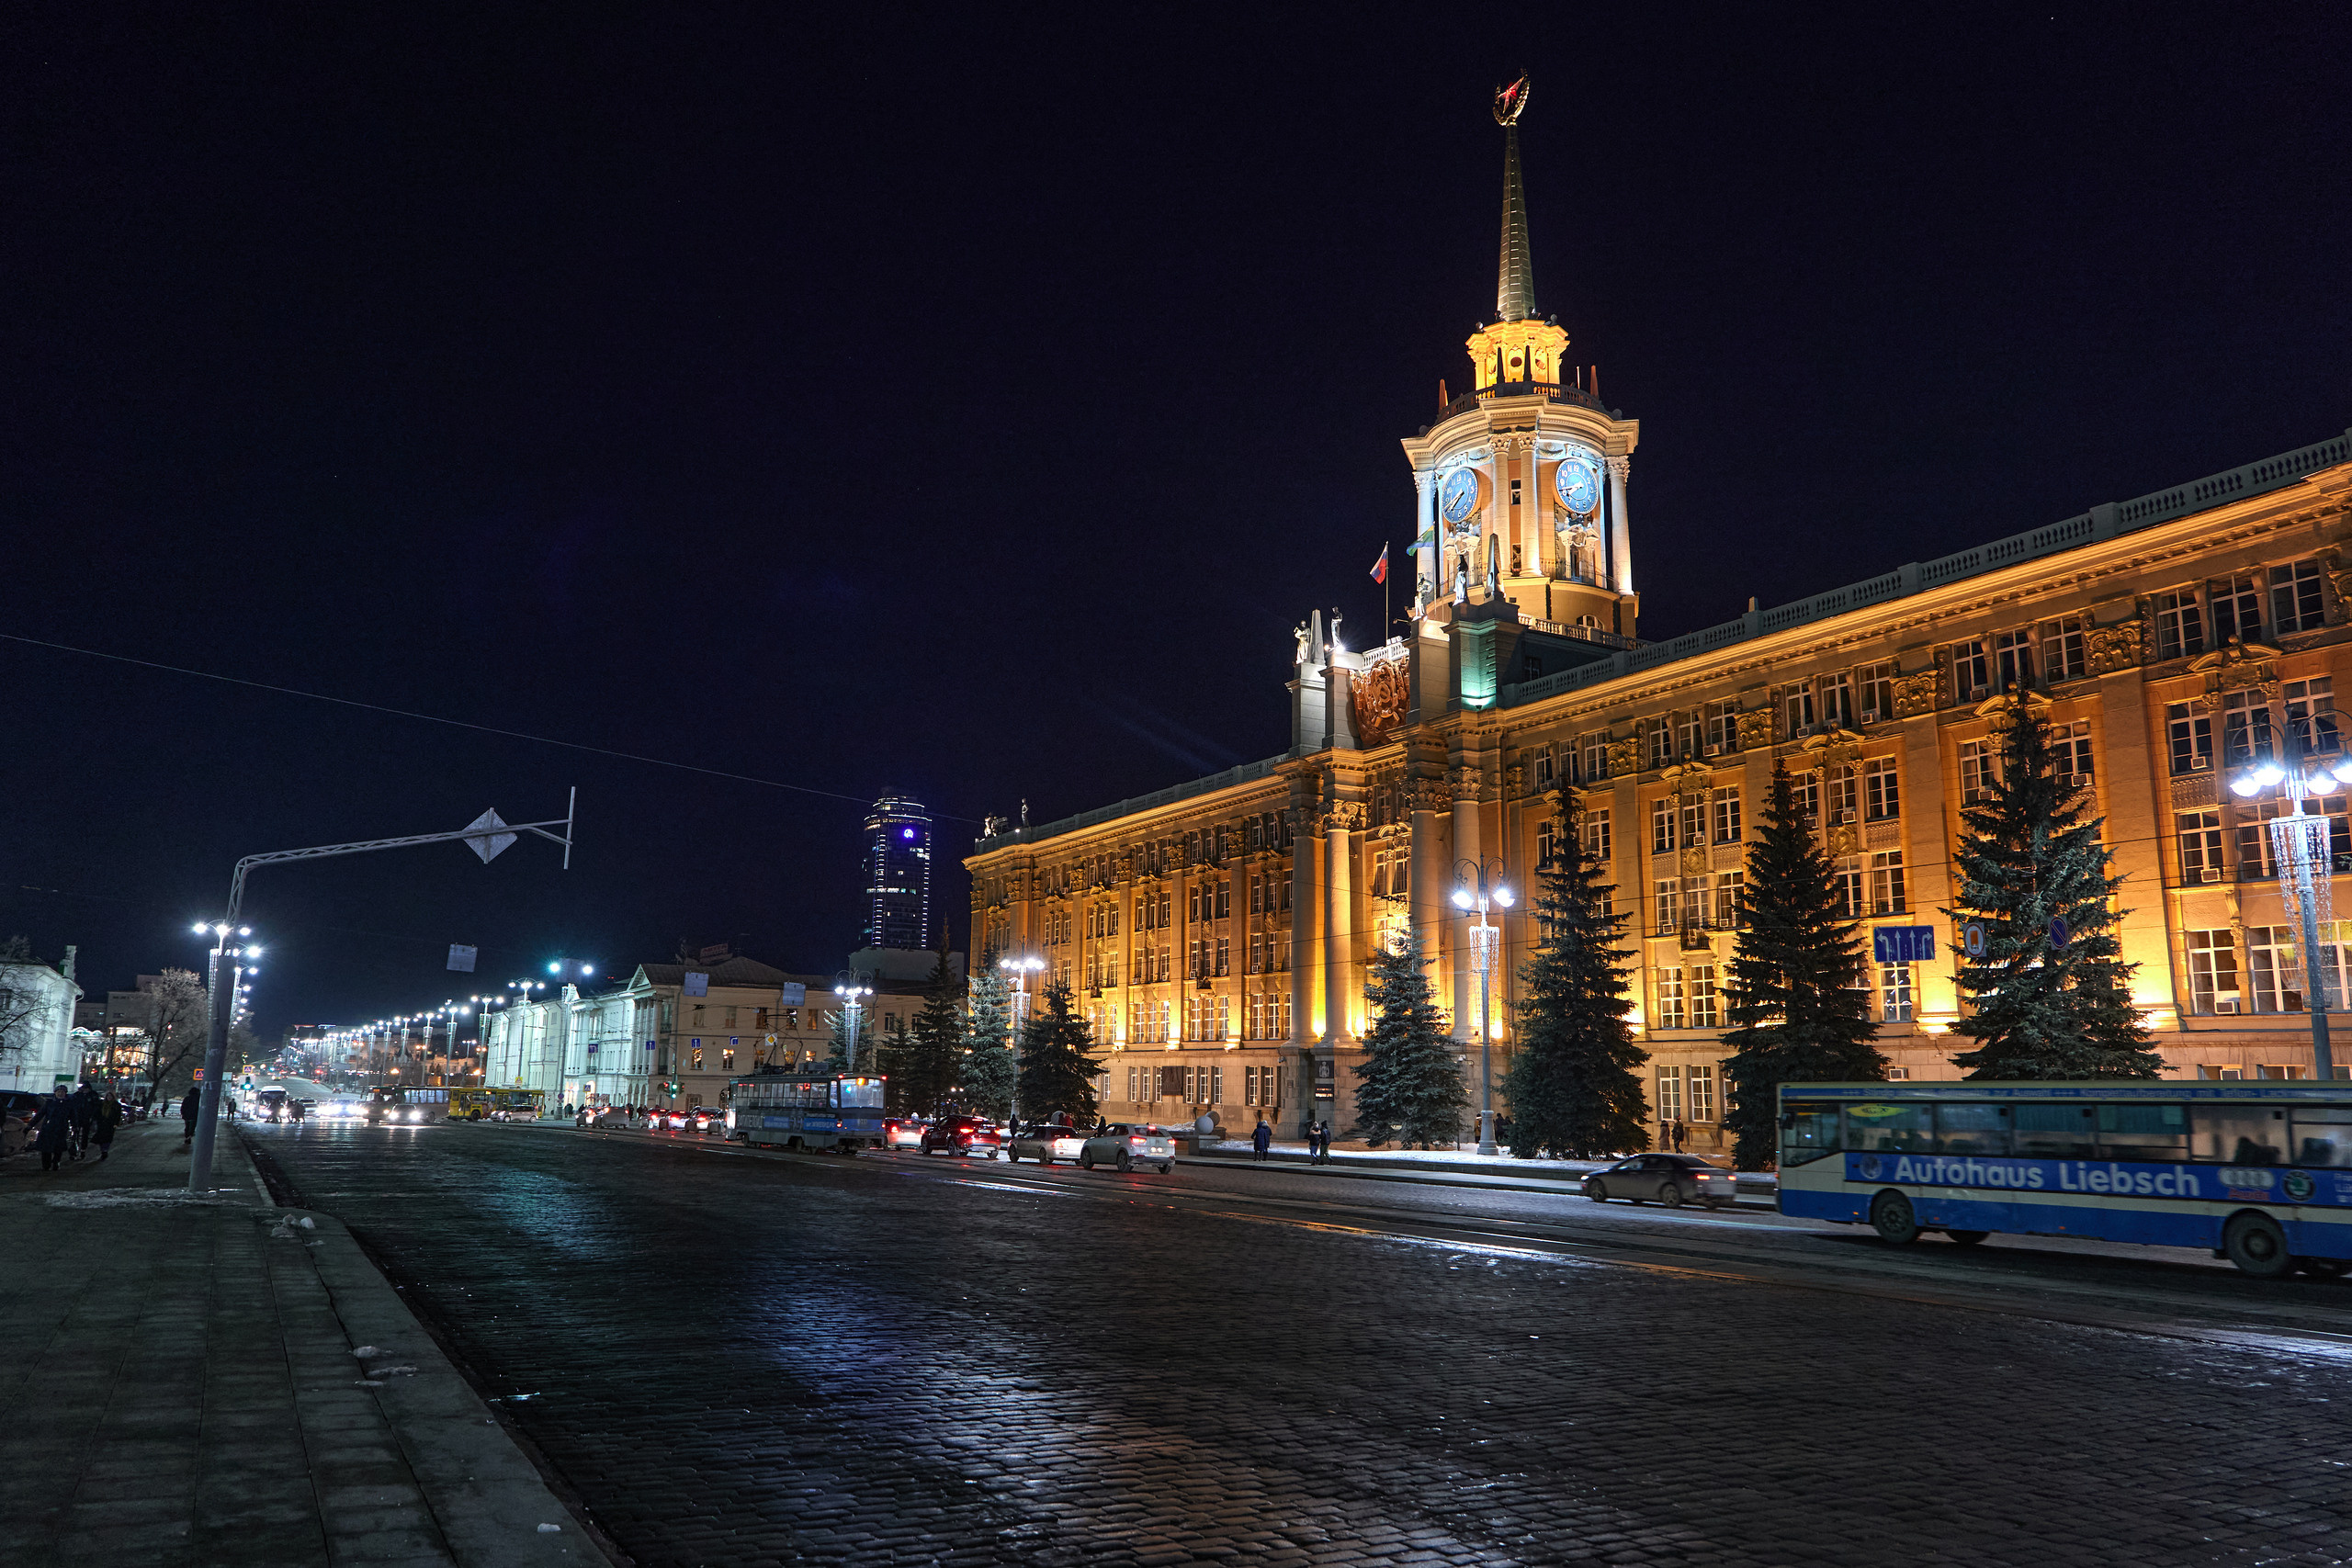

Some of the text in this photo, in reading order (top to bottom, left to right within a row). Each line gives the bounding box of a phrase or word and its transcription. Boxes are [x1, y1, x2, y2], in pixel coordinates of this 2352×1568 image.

[2013, 1089, 2052, 1098] Auswahl
[1894, 1156, 2201, 1196] Autohaus Liebsch
